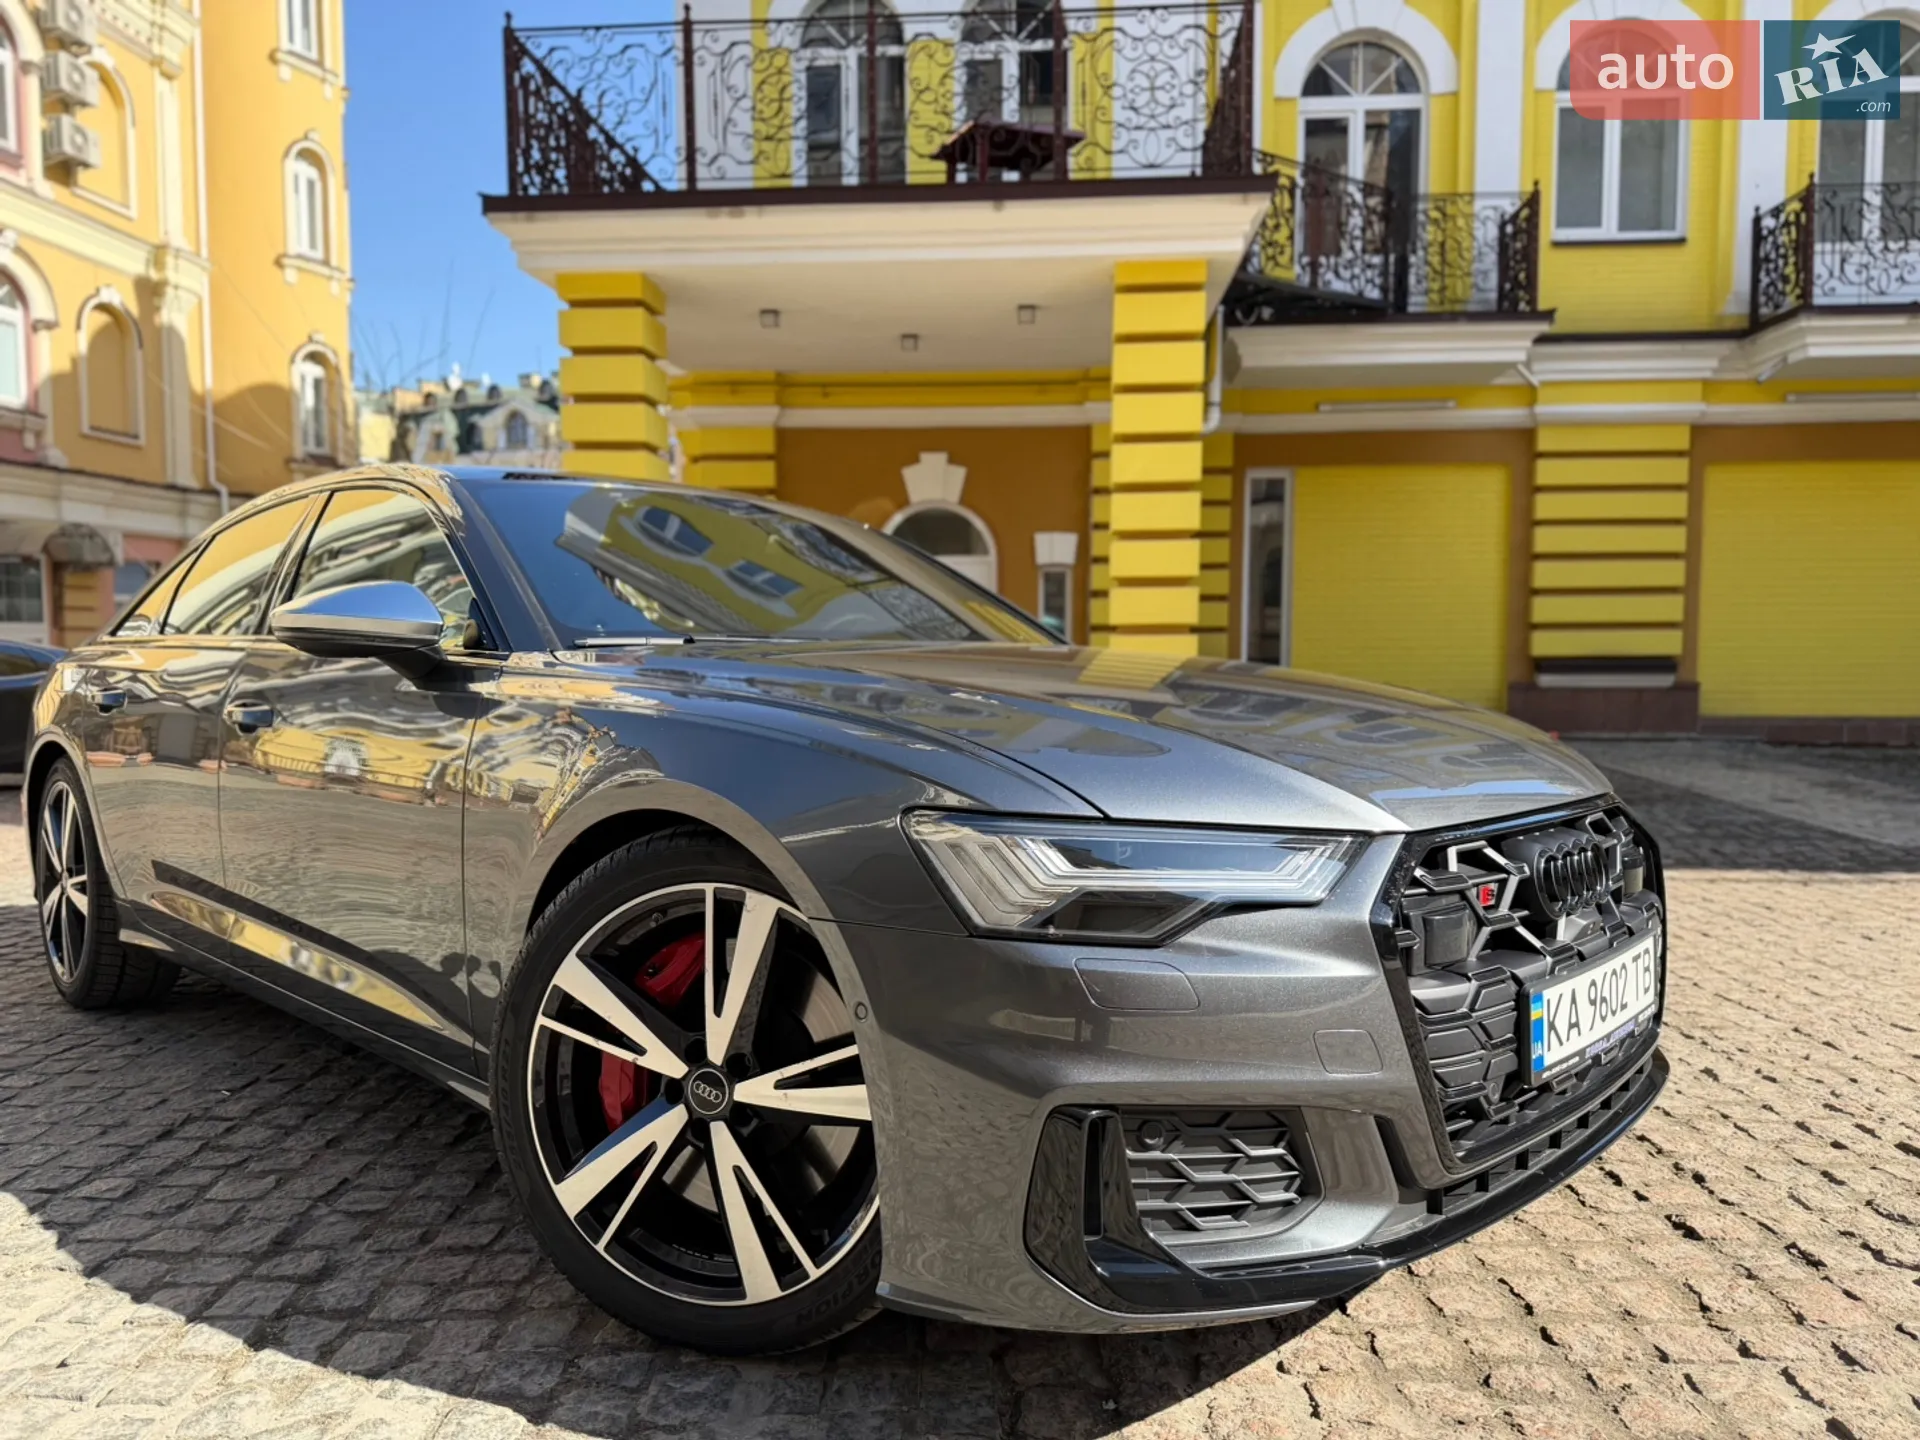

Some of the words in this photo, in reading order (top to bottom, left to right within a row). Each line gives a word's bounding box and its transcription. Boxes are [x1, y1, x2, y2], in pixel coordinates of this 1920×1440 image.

[1547, 988, 1582, 1052] KA
[1587, 962, 1628, 1032] 9602
[1632, 947, 1652, 1002] TB
[1532, 1040, 1543, 1059] UA
